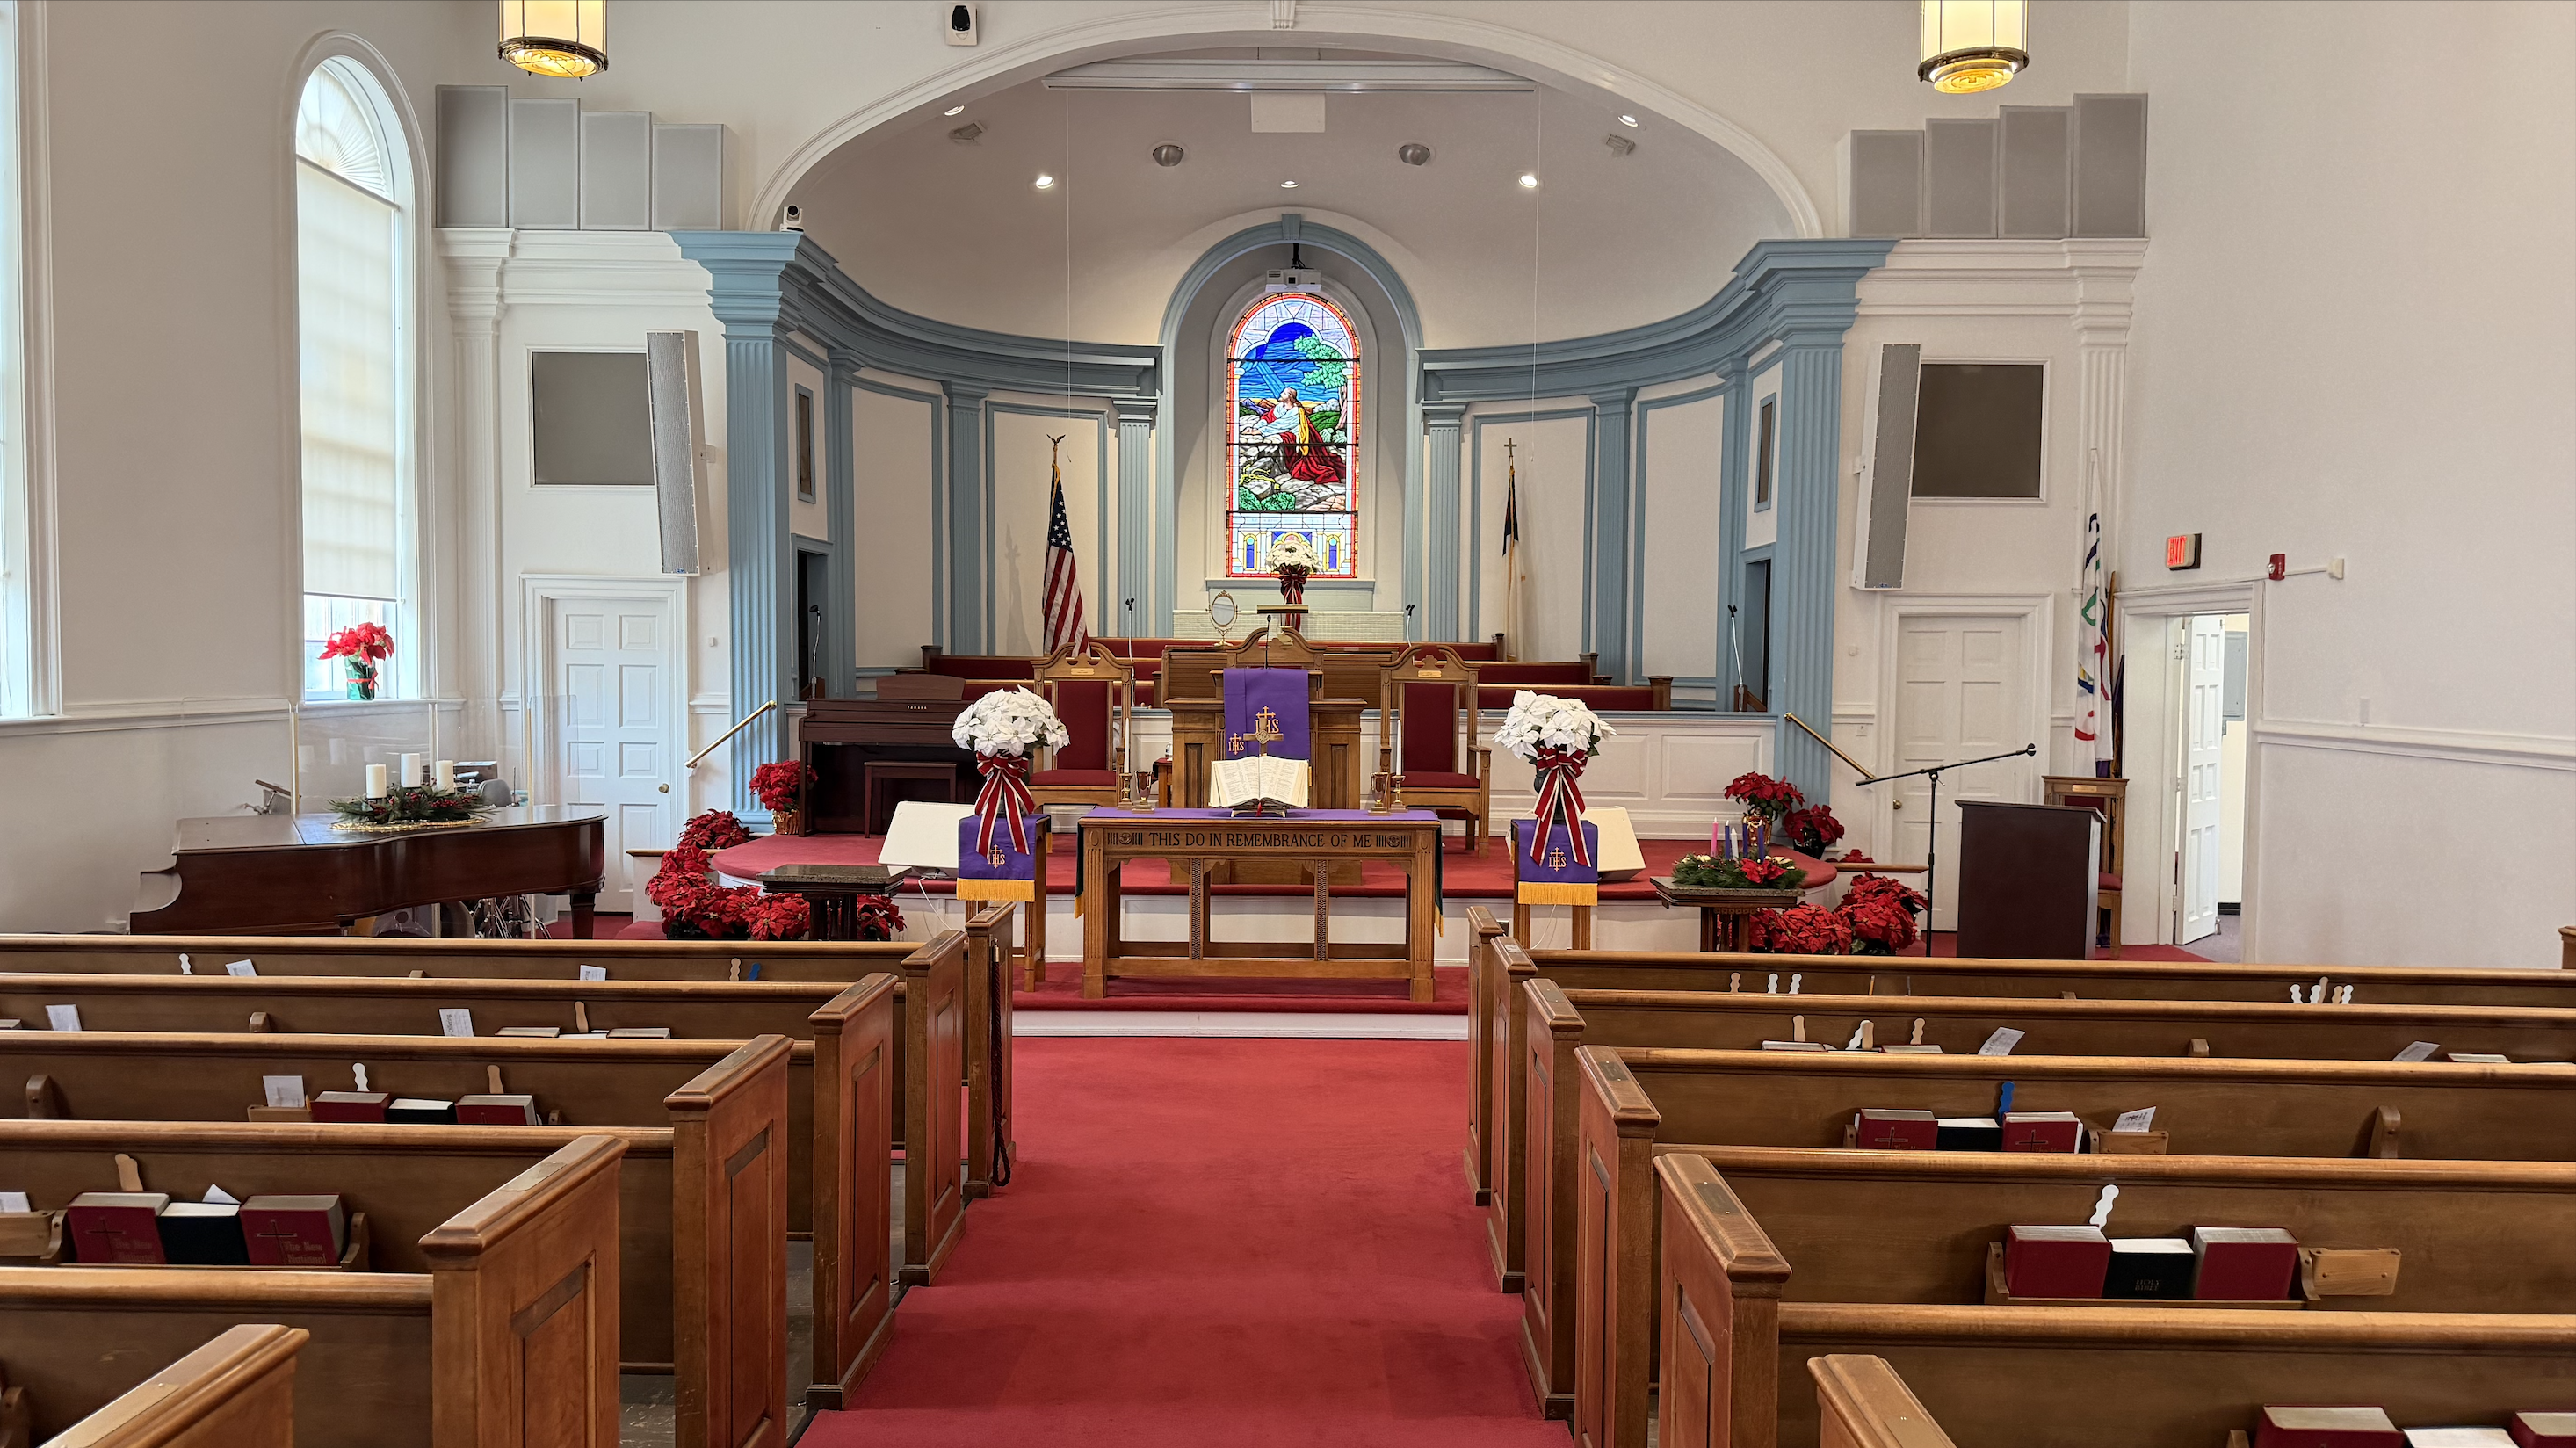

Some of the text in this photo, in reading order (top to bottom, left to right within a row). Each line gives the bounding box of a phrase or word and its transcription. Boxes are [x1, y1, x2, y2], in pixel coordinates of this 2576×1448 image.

[1148, 832, 1372, 848] THIS DO IN REMEMBRANCE OF ME
[283, 1240, 323, 1252] The New
